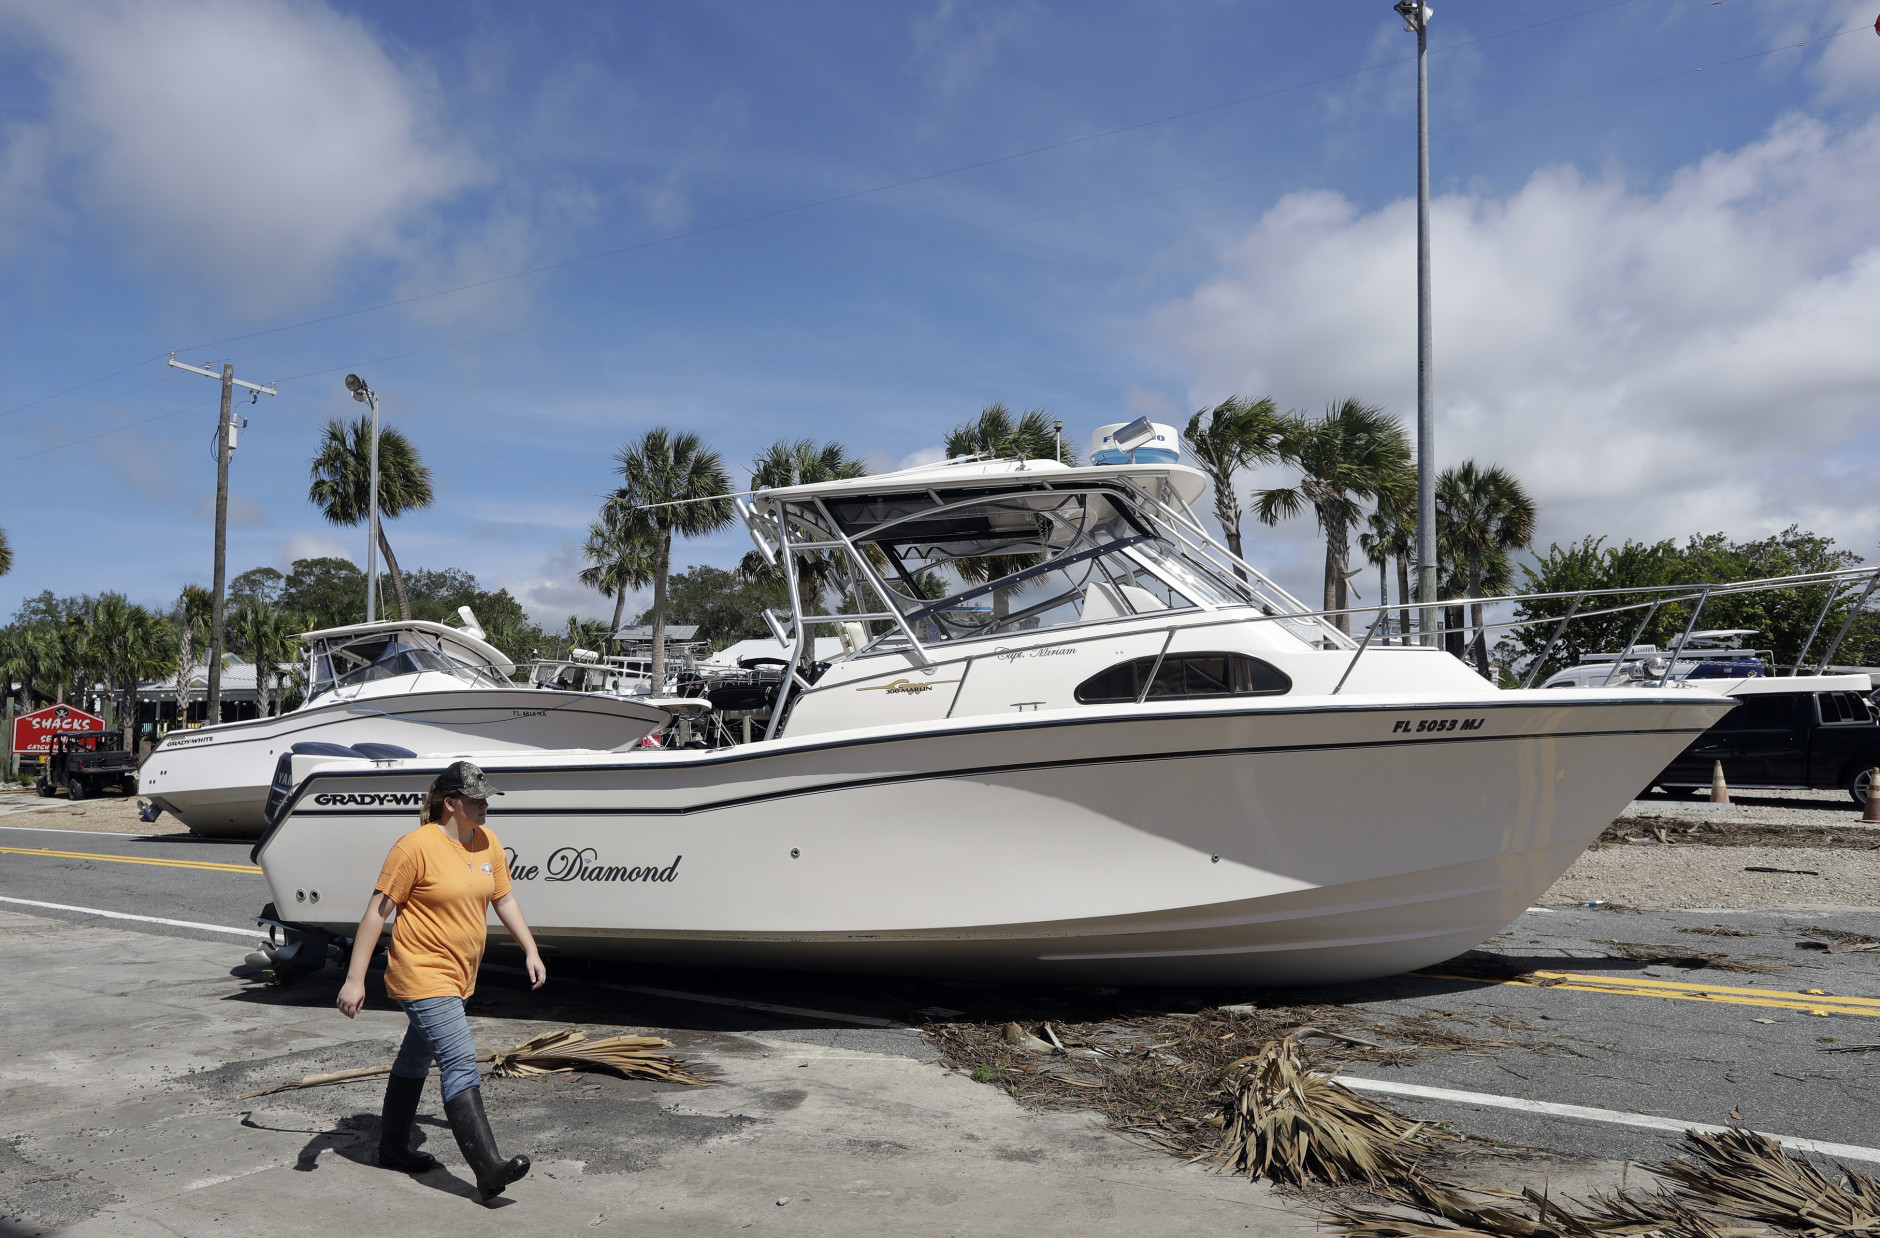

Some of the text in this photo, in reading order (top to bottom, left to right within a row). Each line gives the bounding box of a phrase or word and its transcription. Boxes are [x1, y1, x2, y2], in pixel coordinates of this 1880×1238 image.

[1029, 645, 1077, 658] Miriam
[901, 685, 933, 693] MARLIN
[31, 717, 91, 730] SHACKS
[1392, 718, 1486, 733] FL 5053 MJ
[166, 736, 214, 747] GRADY-WHITE
[544, 847, 683, 882] Diamond
